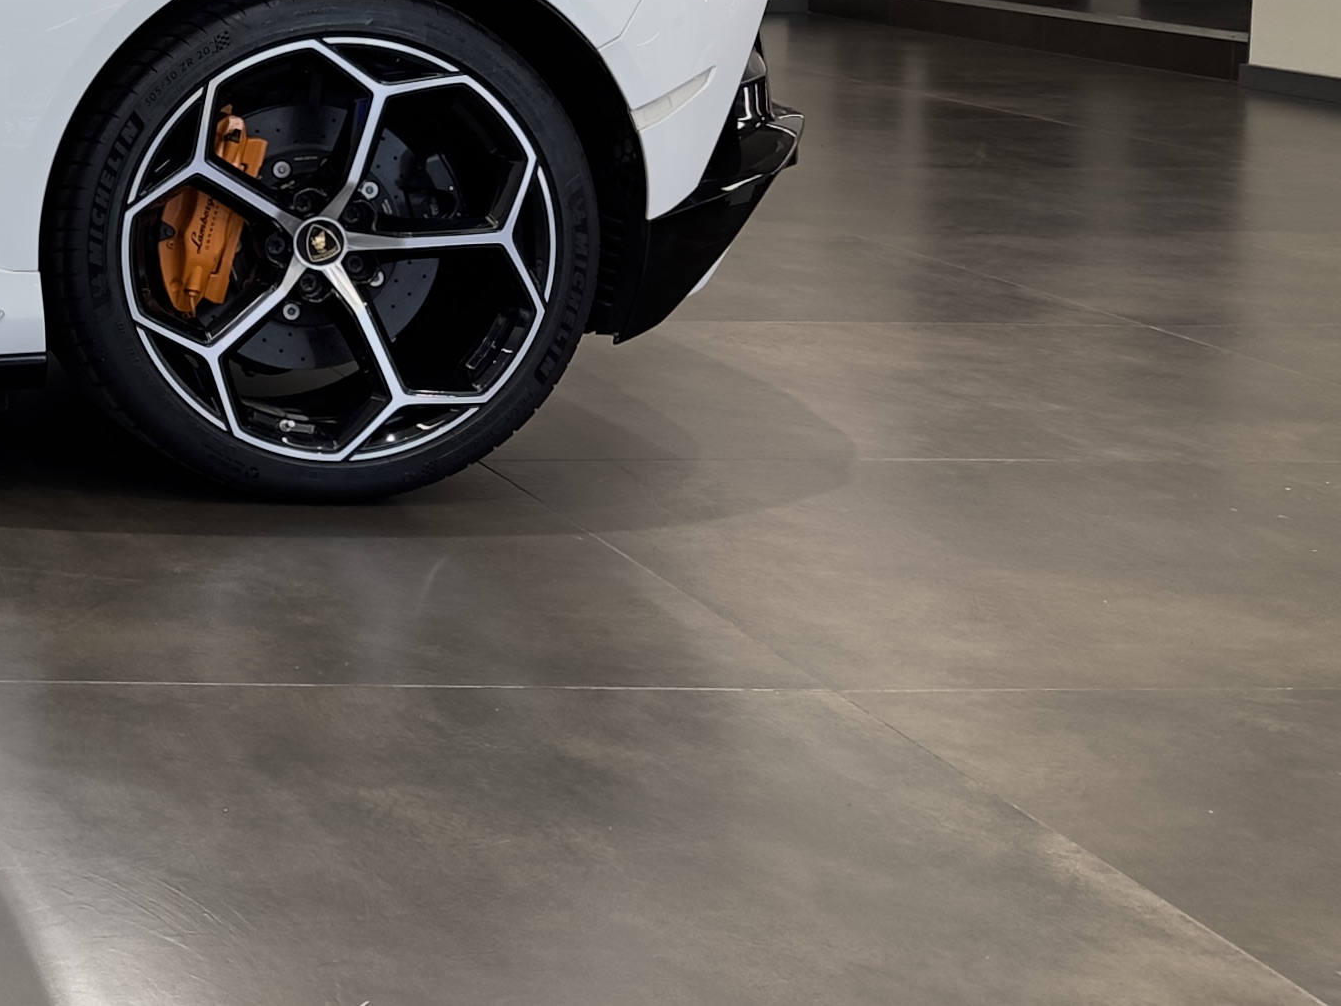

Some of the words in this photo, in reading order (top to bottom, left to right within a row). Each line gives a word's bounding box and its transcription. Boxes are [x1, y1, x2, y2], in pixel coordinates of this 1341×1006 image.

[88, 116, 141, 266] MICHELIN
[190, 197, 215, 255] Lamborg
[536, 230, 589, 379] MICHELIN
